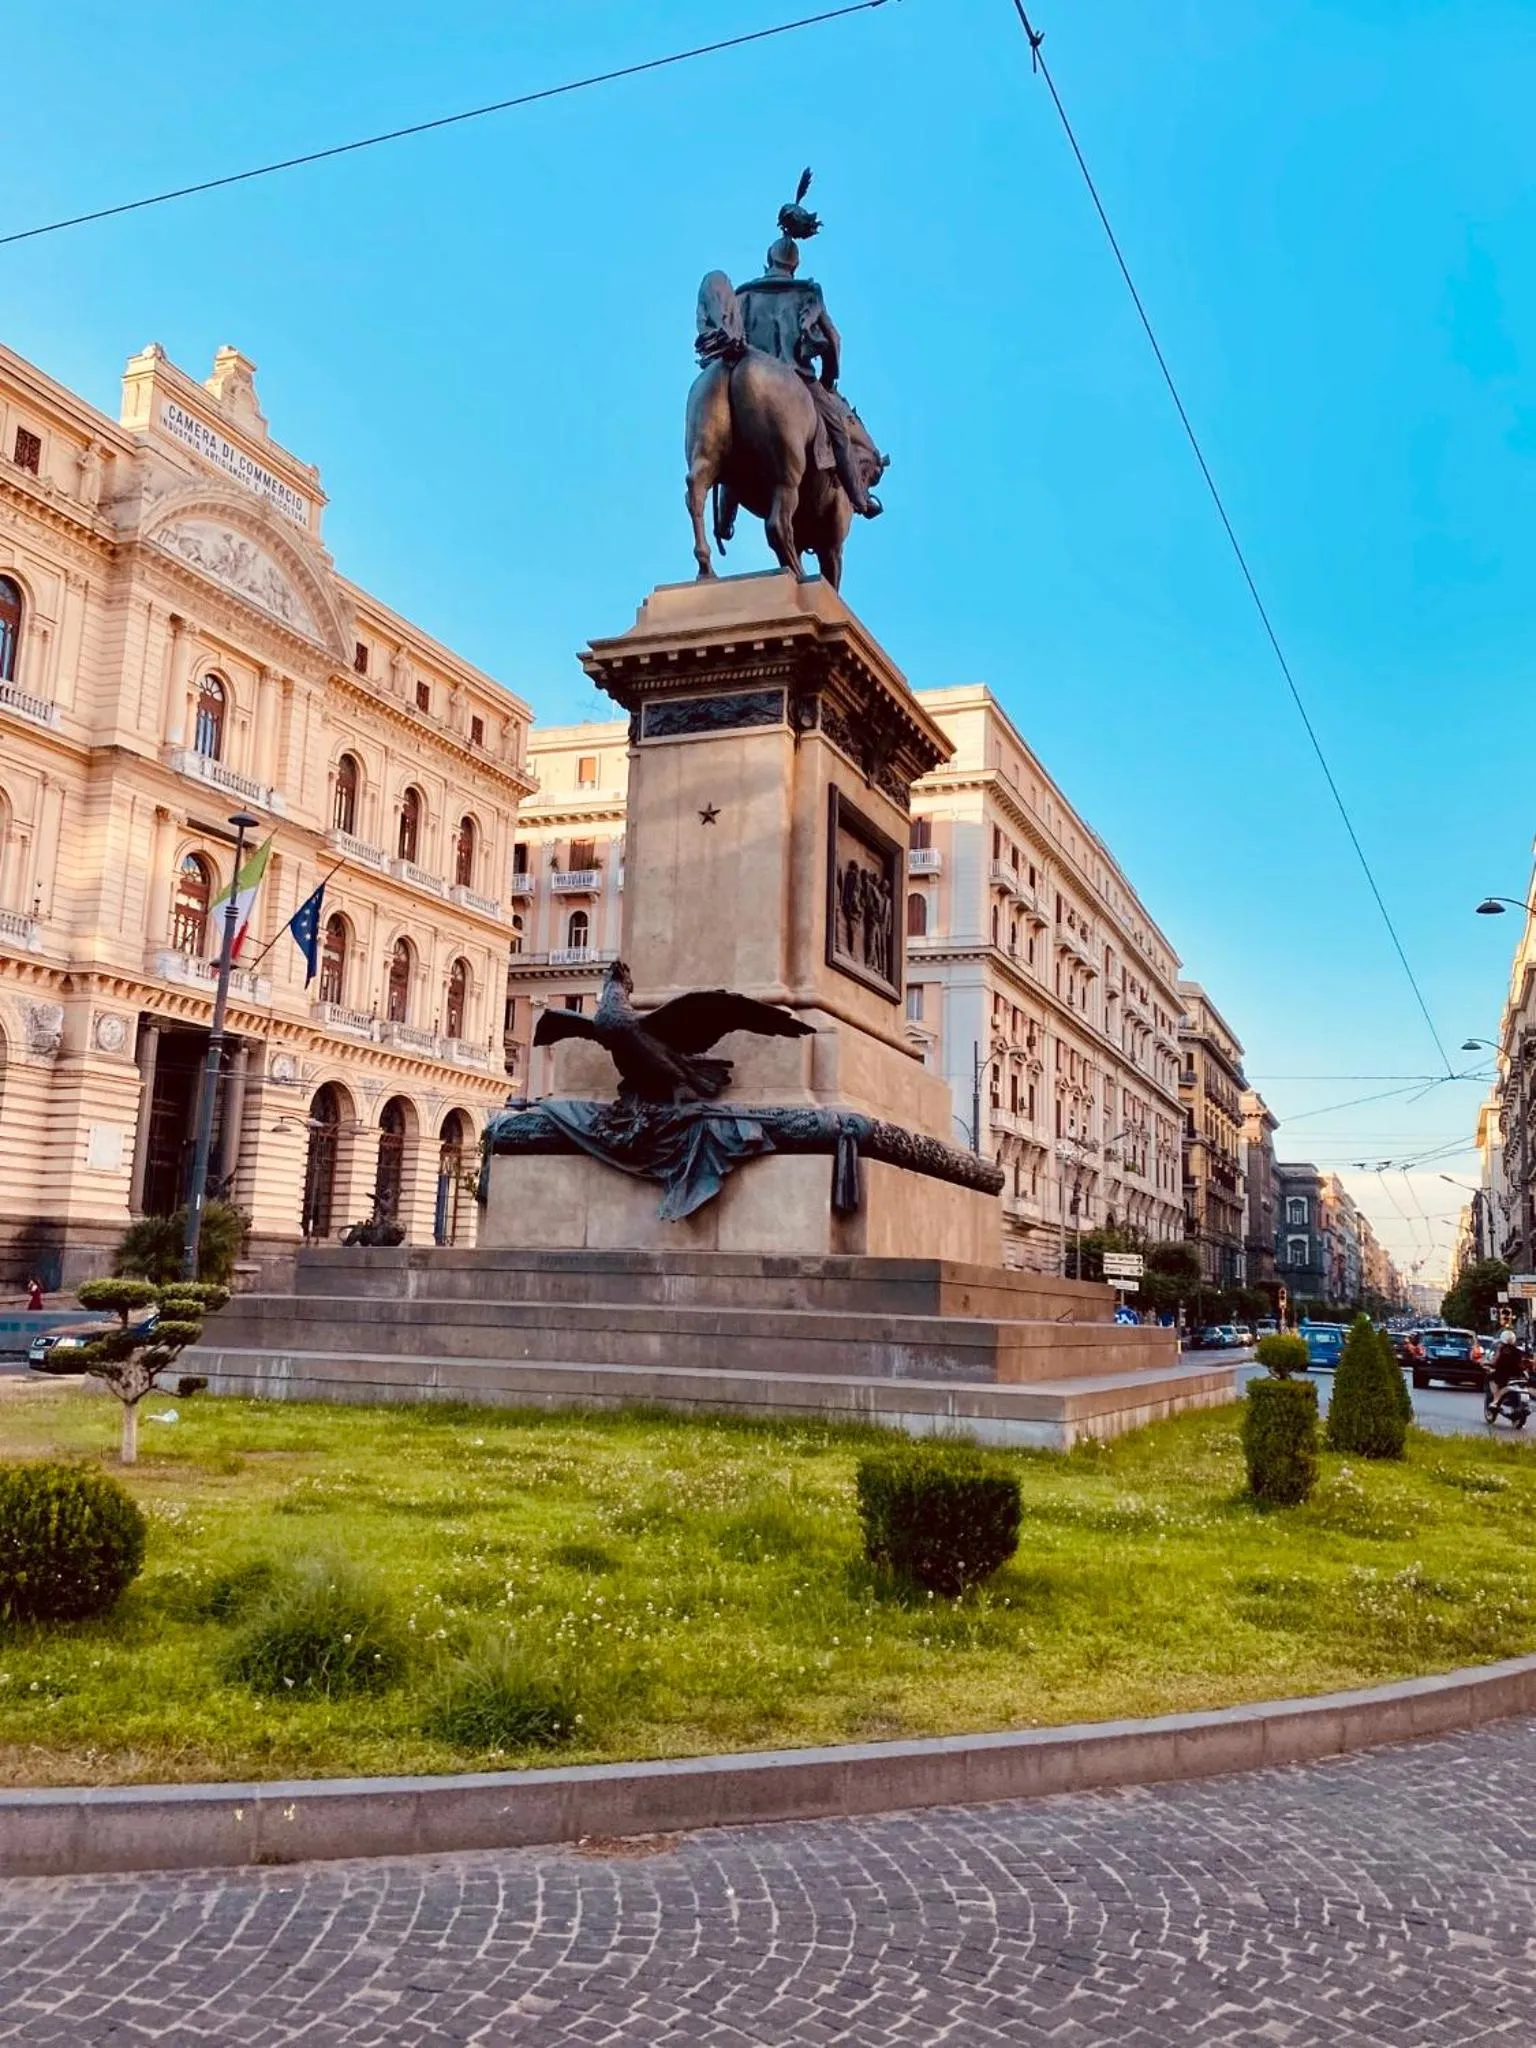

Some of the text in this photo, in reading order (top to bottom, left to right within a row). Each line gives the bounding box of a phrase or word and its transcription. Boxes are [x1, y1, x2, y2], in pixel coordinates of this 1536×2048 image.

[169, 405, 303, 511] CAMERA DI COMMERCIO
